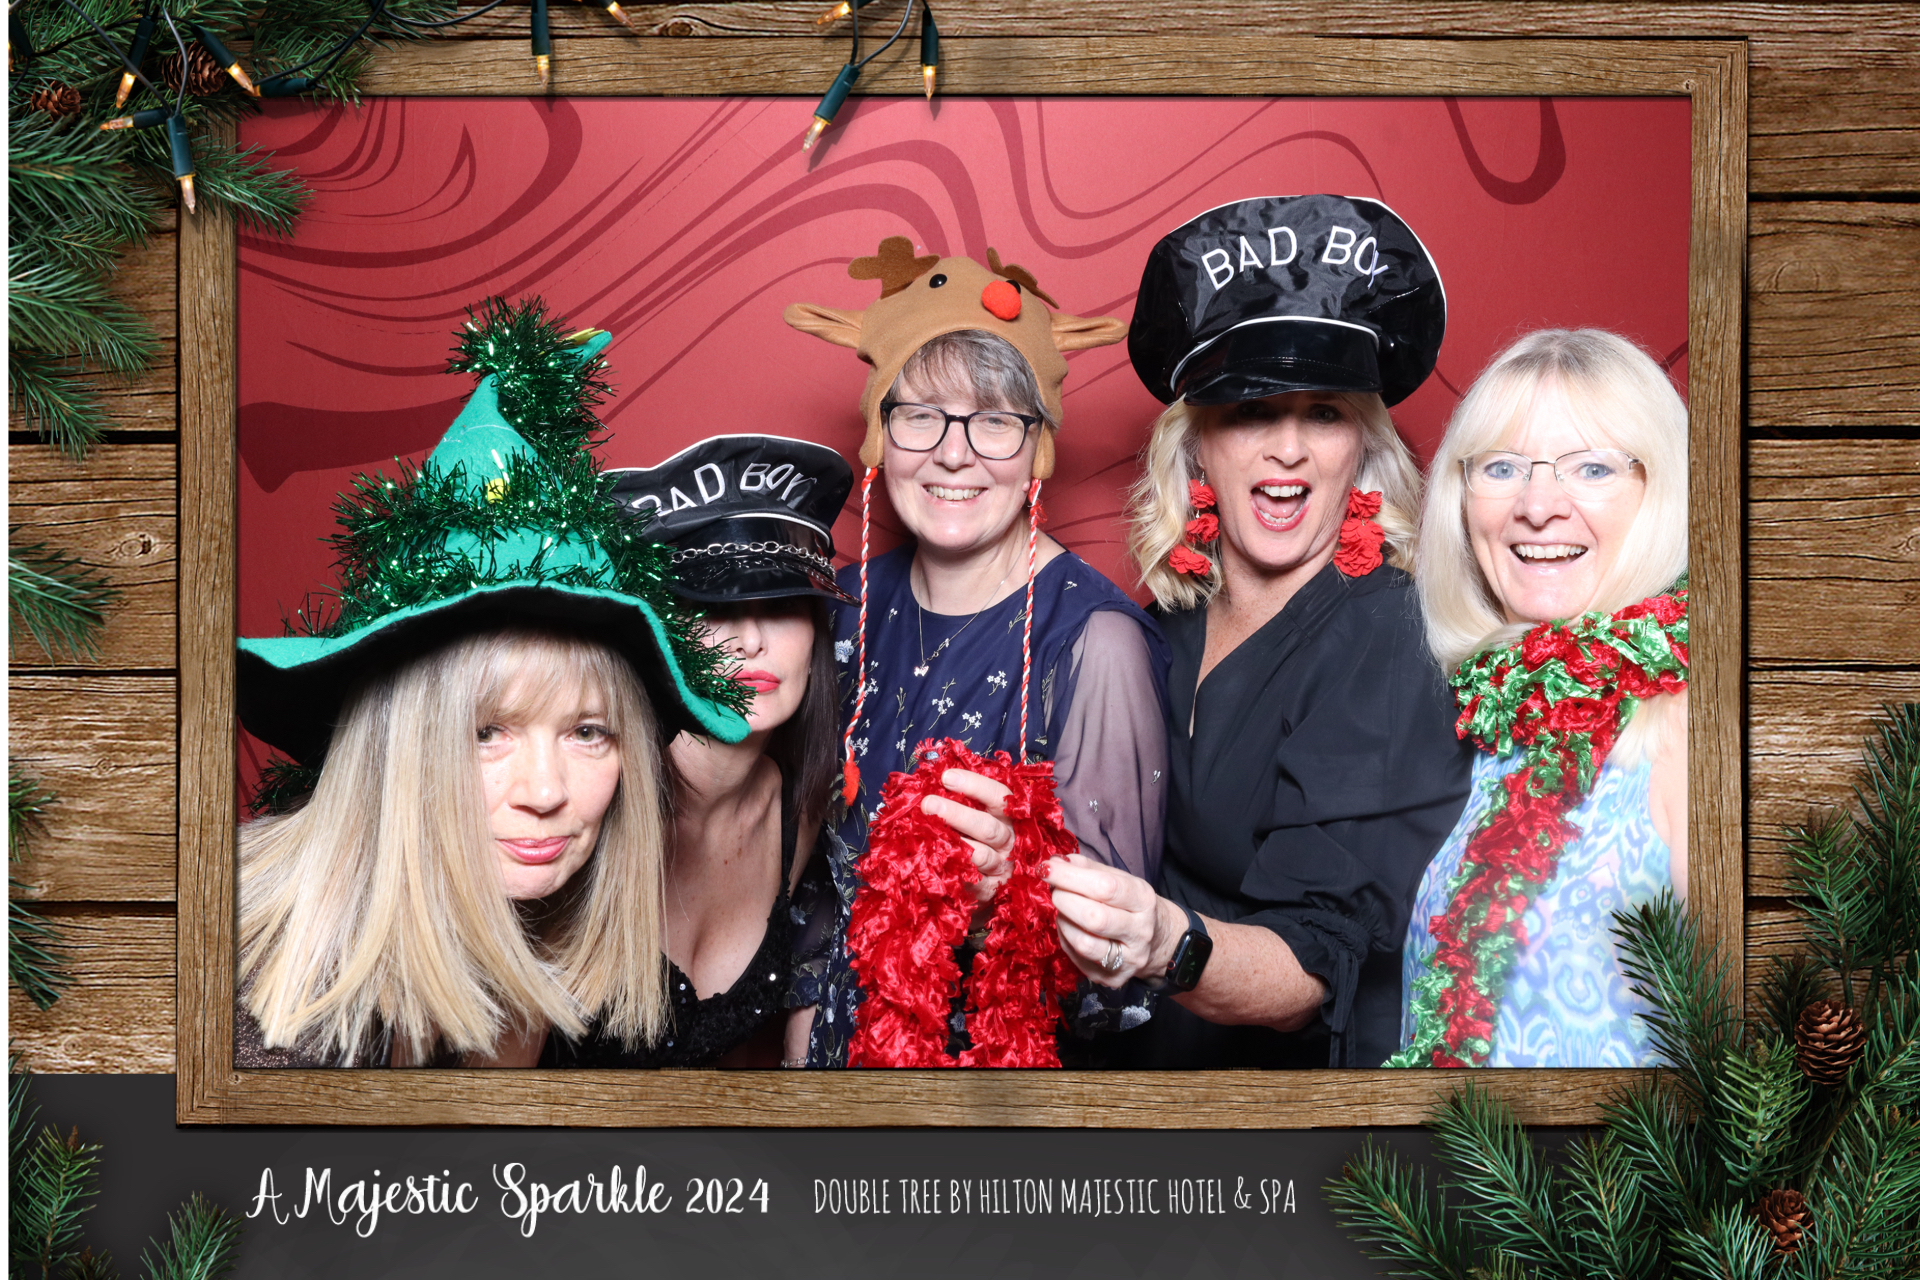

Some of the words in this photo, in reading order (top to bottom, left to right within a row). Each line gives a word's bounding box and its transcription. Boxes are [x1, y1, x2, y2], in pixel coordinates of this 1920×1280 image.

[1201, 226, 1298, 291] BAD
[1322, 225, 1389, 290] BOY
[740, 463, 818, 501] BOY
